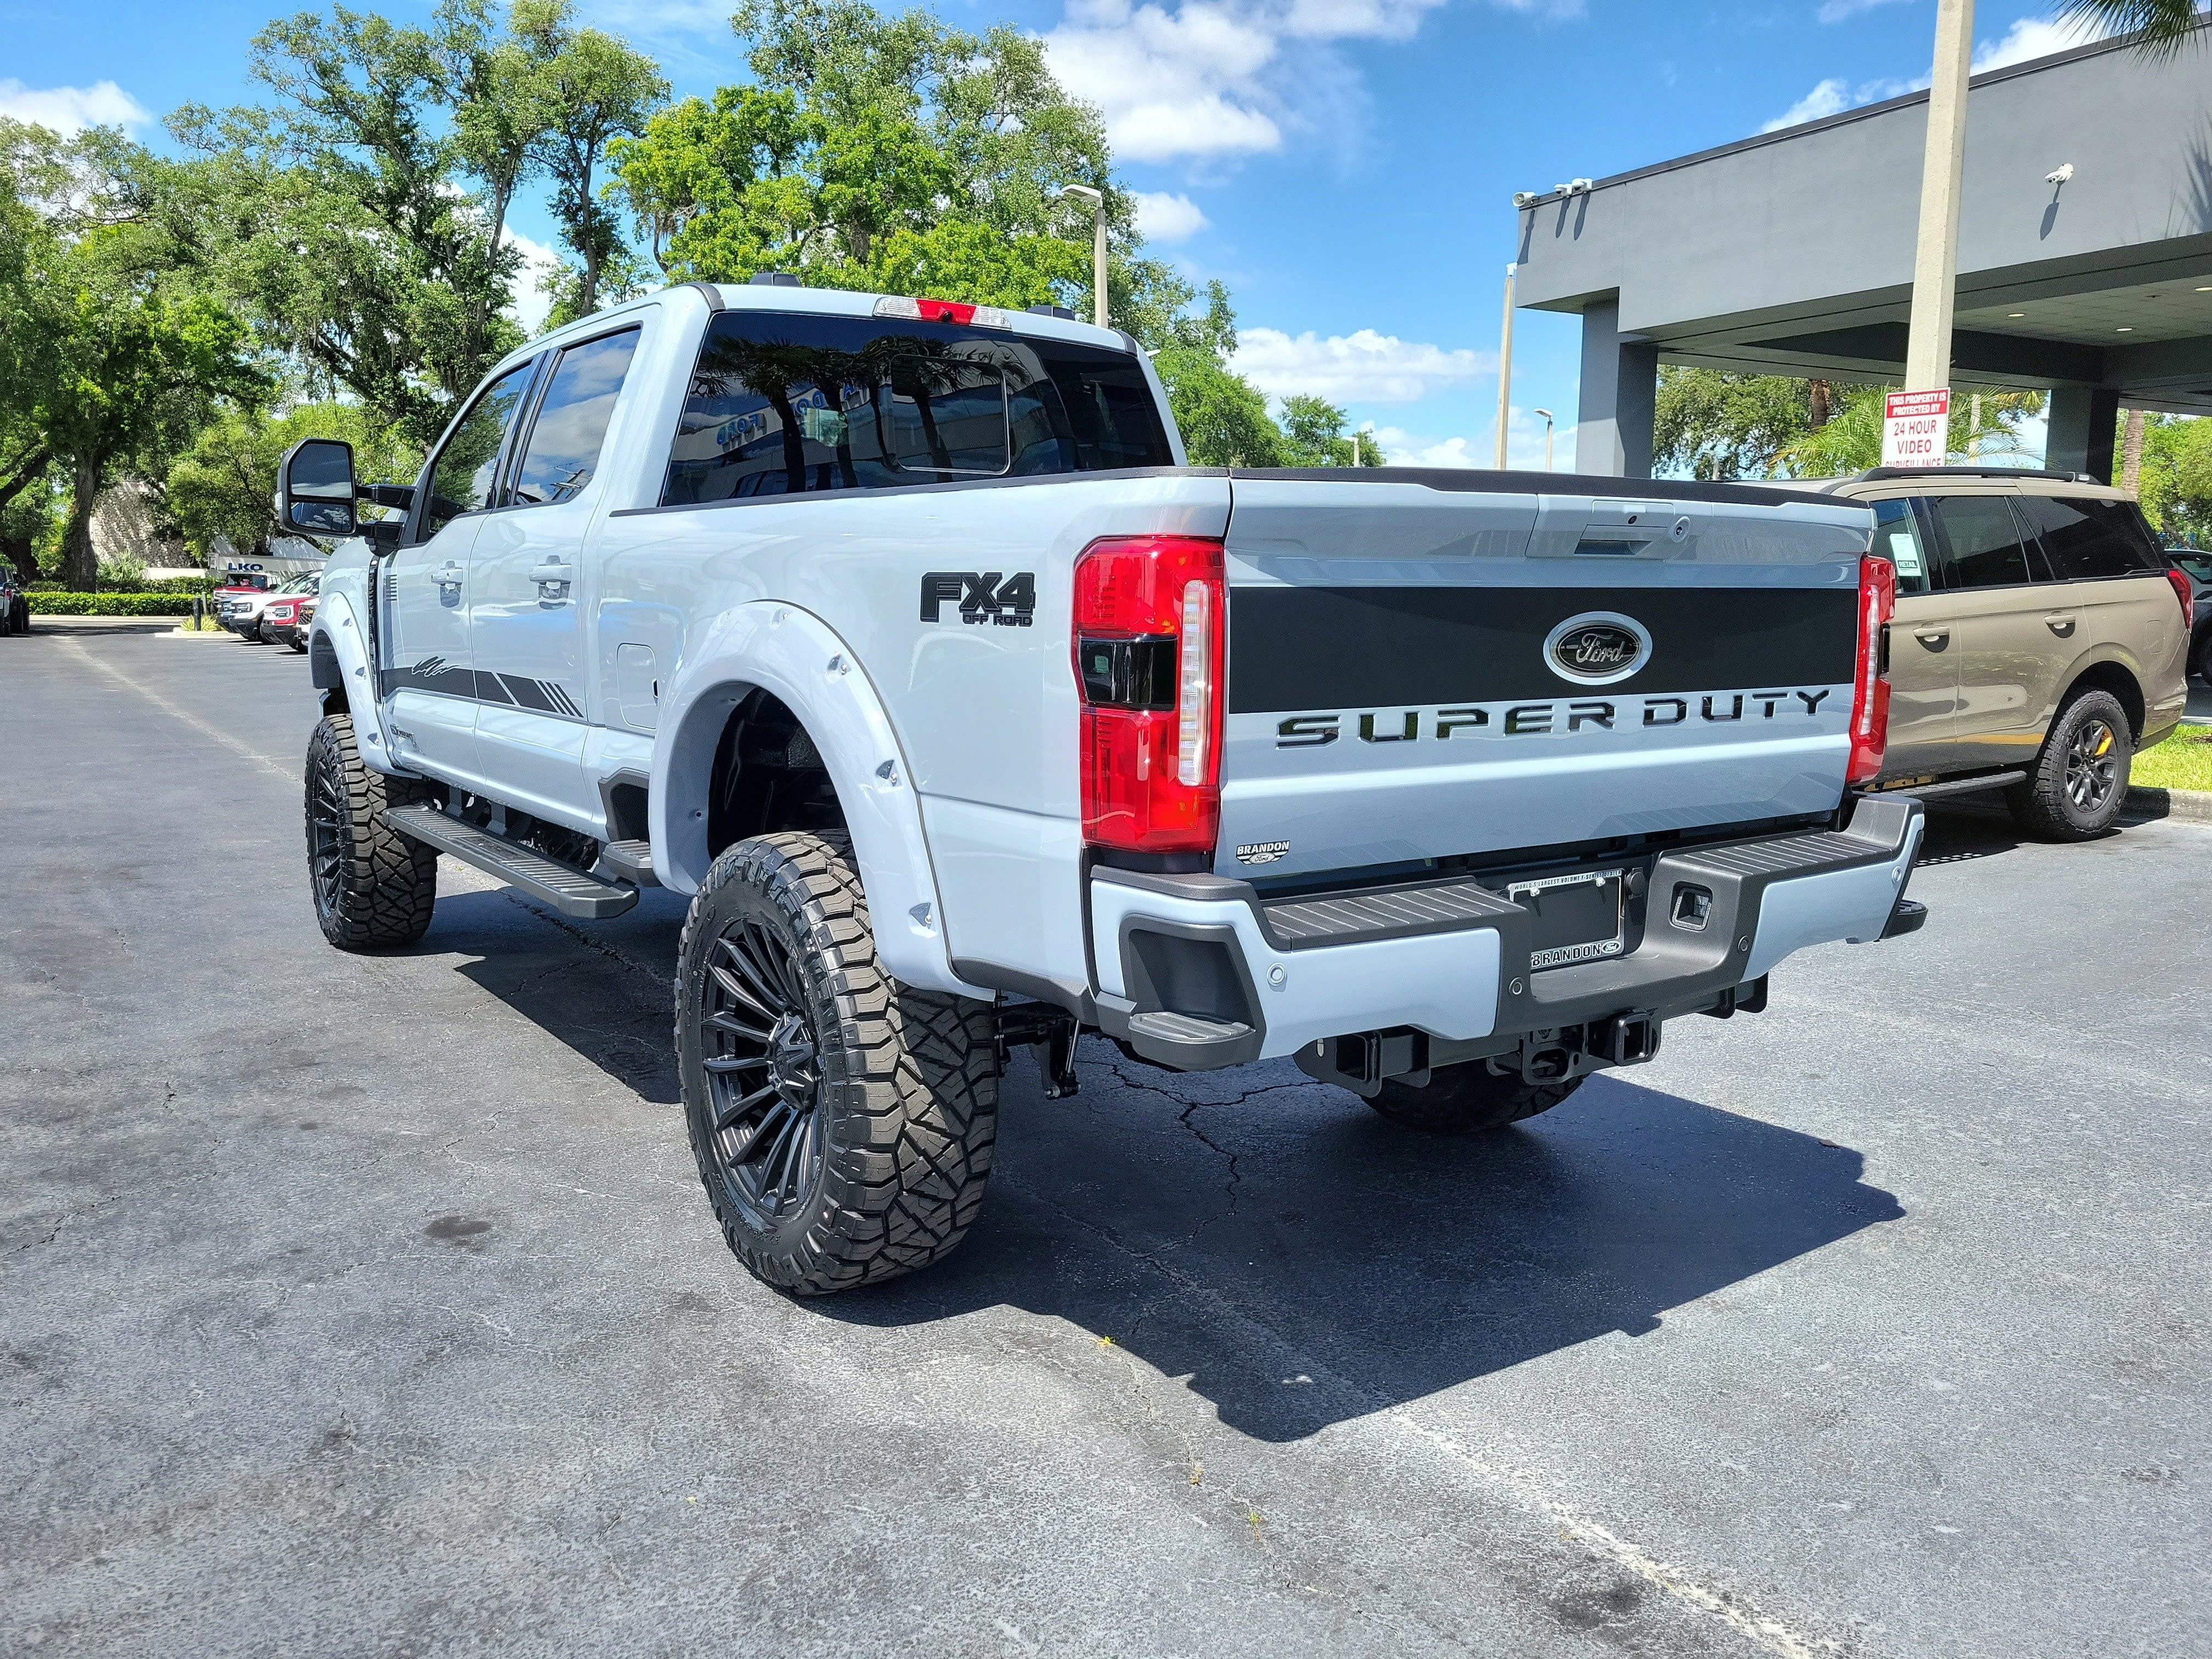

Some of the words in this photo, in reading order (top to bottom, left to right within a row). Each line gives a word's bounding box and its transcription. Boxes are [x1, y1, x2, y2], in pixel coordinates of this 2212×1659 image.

[1889, 396, 1904, 405] THIS
[1905, 392, 1939, 404] PROPERTY
[1939, 392, 1946, 402] IS
[1892, 404, 1930, 416] PROTECTED
[1930, 403, 1940, 413] BY
[1894, 422, 1905, 436] 24
[1909, 420, 1937, 435] HOUR
[1898, 439, 1932, 454] VIDEO
[920, 572, 1036, 623] FX4
[962, 613, 989, 625] OFF
[993, 614, 1033, 627] ROAD
[1576, 633, 1625, 663] Ford
[1276, 702, 1616, 749] SUPER
[1642, 689, 1832, 728] DUTY
[1237, 840, 1290, 855] BRANDON
[1538, 878, 1560, 887] LARGEST
[1581, 872, 1602, 880] F-SERIES
[1531, 943, 1602, 968] BRANDON
[1605, 943, 1617, 951] Ford
